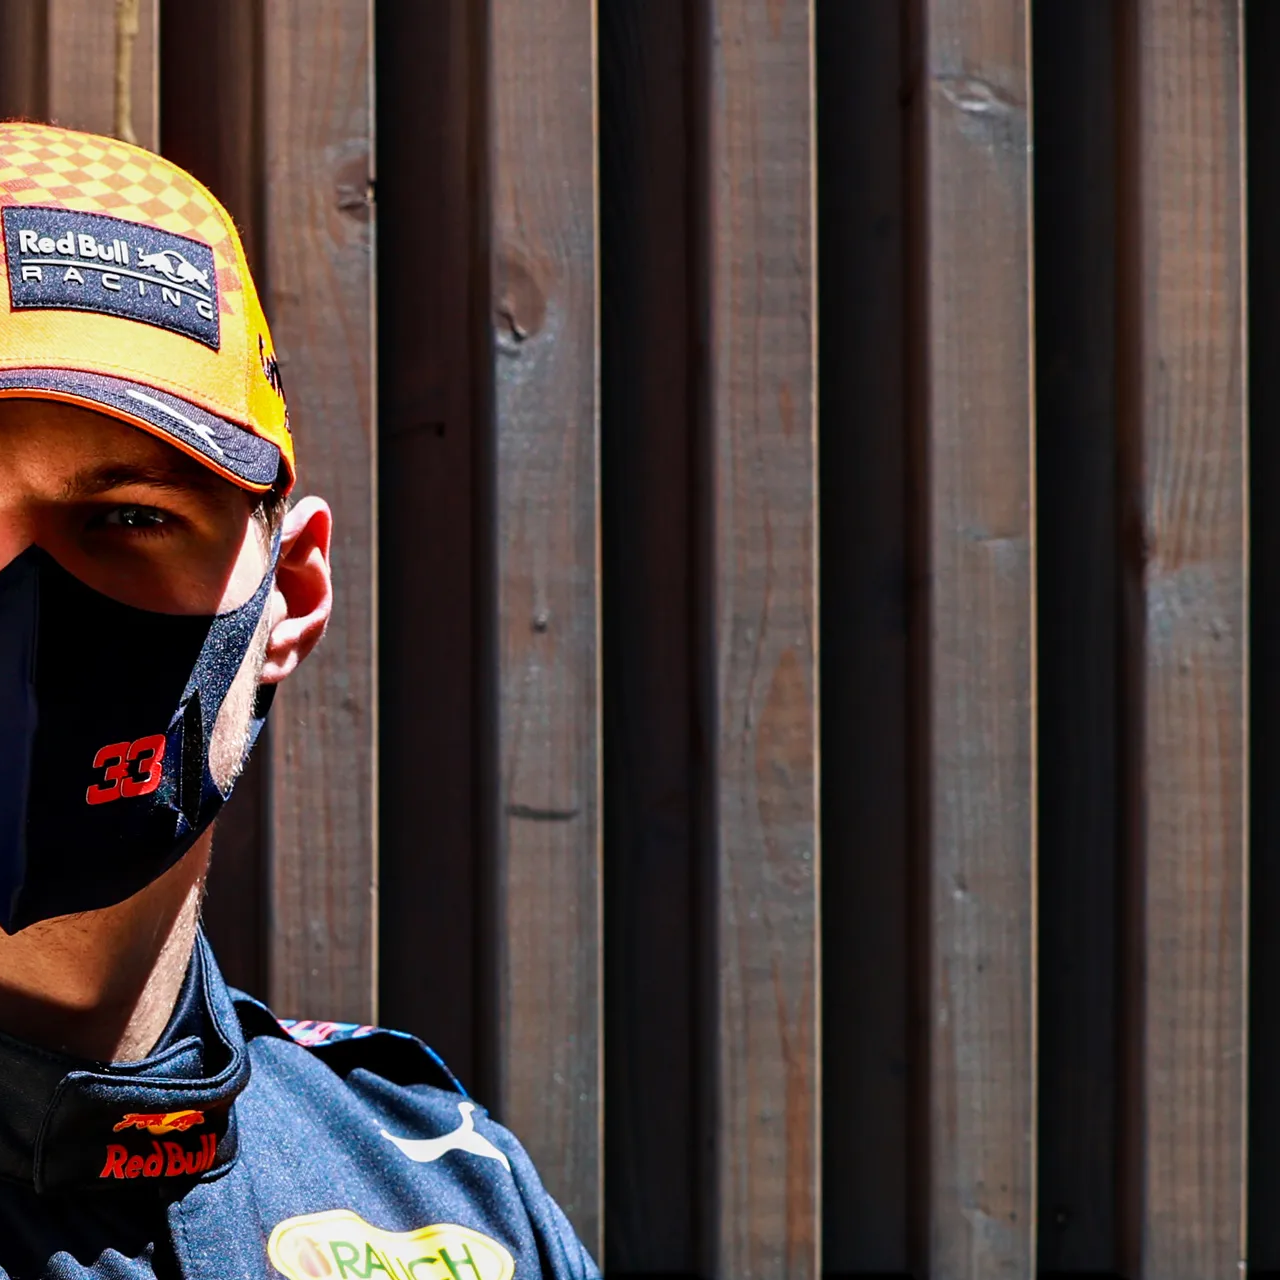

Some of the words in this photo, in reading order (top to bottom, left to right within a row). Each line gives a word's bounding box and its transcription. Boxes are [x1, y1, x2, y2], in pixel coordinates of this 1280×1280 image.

[19, 230, 73, 255] Red
[77, 233, 130, 266] Bull
[21, 266, 215, 321] RACING
[85, 733, 167, 805] 33
[99, 1138, 164, 1180] Red
[163, 1132, 217, 1177] Bull
